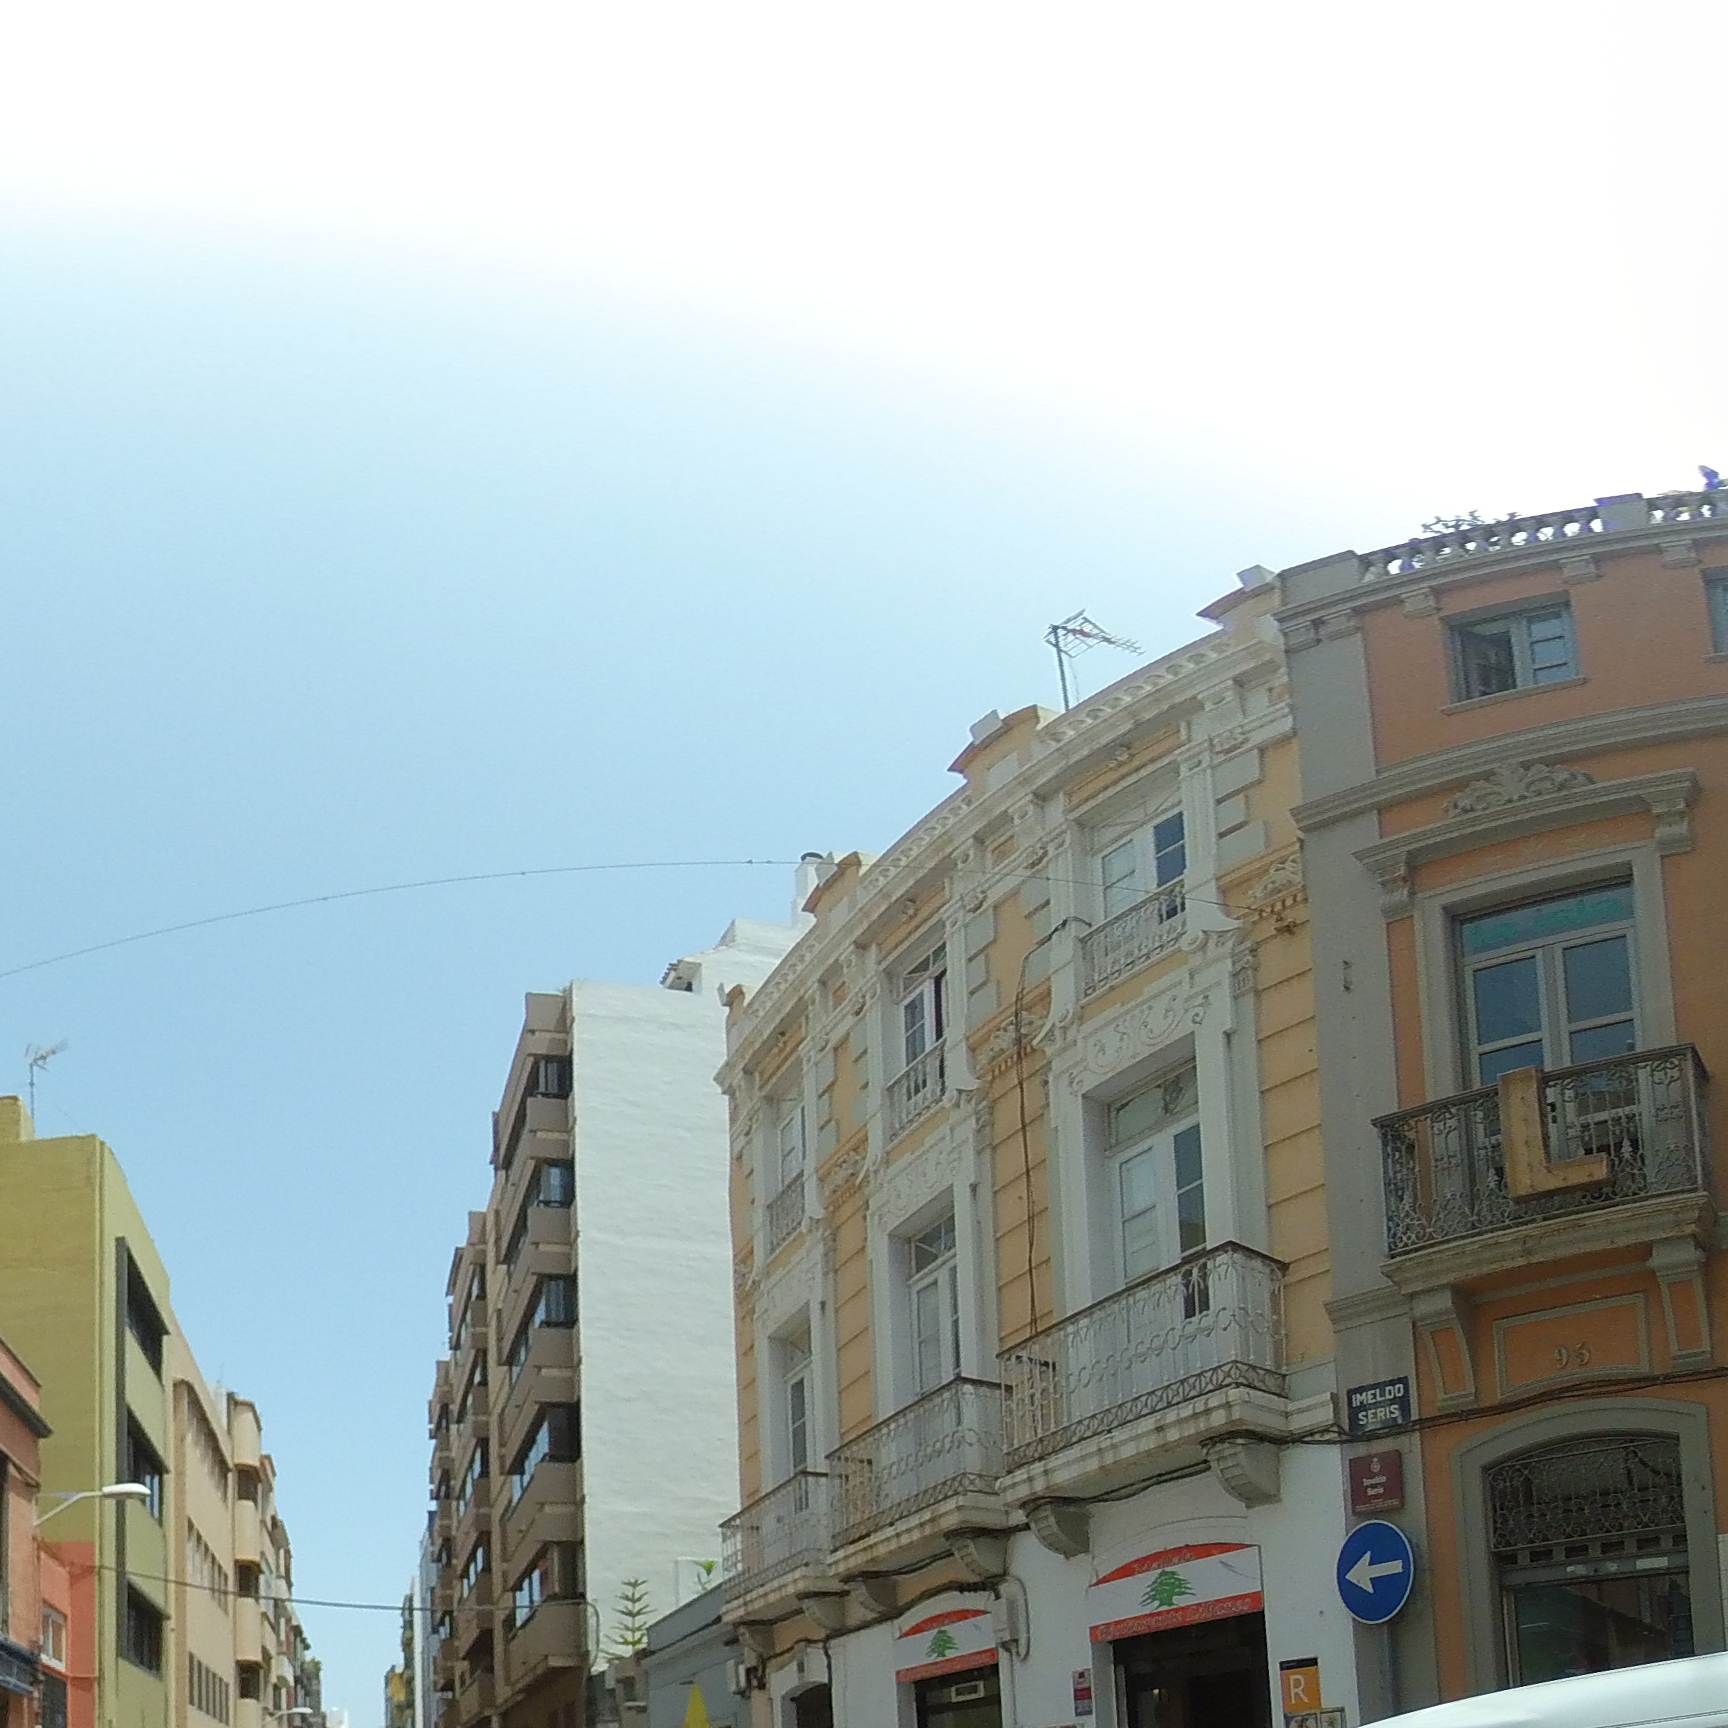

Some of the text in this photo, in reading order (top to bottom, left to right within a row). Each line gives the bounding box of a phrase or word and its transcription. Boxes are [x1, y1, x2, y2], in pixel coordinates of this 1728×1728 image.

[1352, 1383, 1405, 1407] IMELDO
[1358, 1404, 1400, 1425] SERIS
[1289, 1674, 1310, 1704] R
